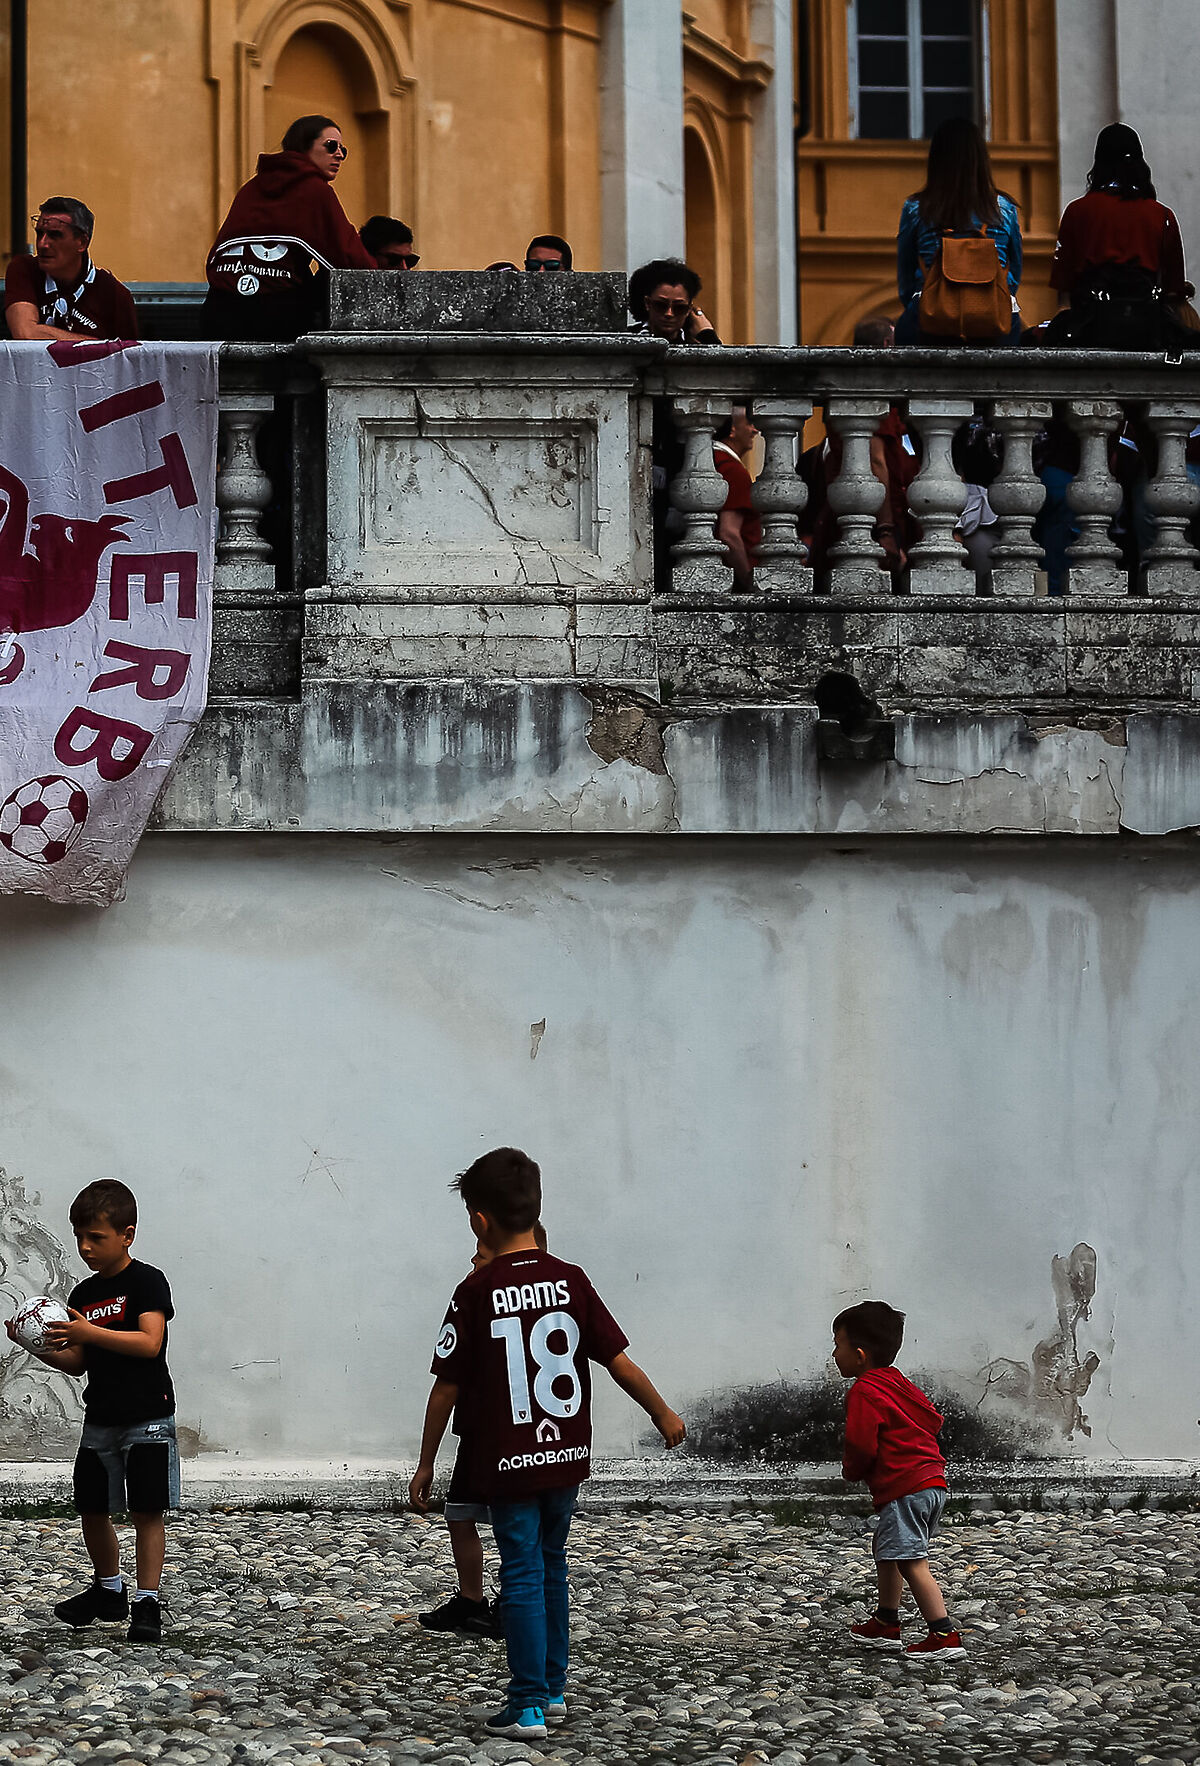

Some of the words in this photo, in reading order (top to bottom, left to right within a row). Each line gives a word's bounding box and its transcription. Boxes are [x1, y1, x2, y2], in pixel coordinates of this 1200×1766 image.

[492, 1280, 571, 1314] ADAMS
[490, 1311, 583, 1425] 18
[498, 1445, 589, 1471] ACROBATICA
